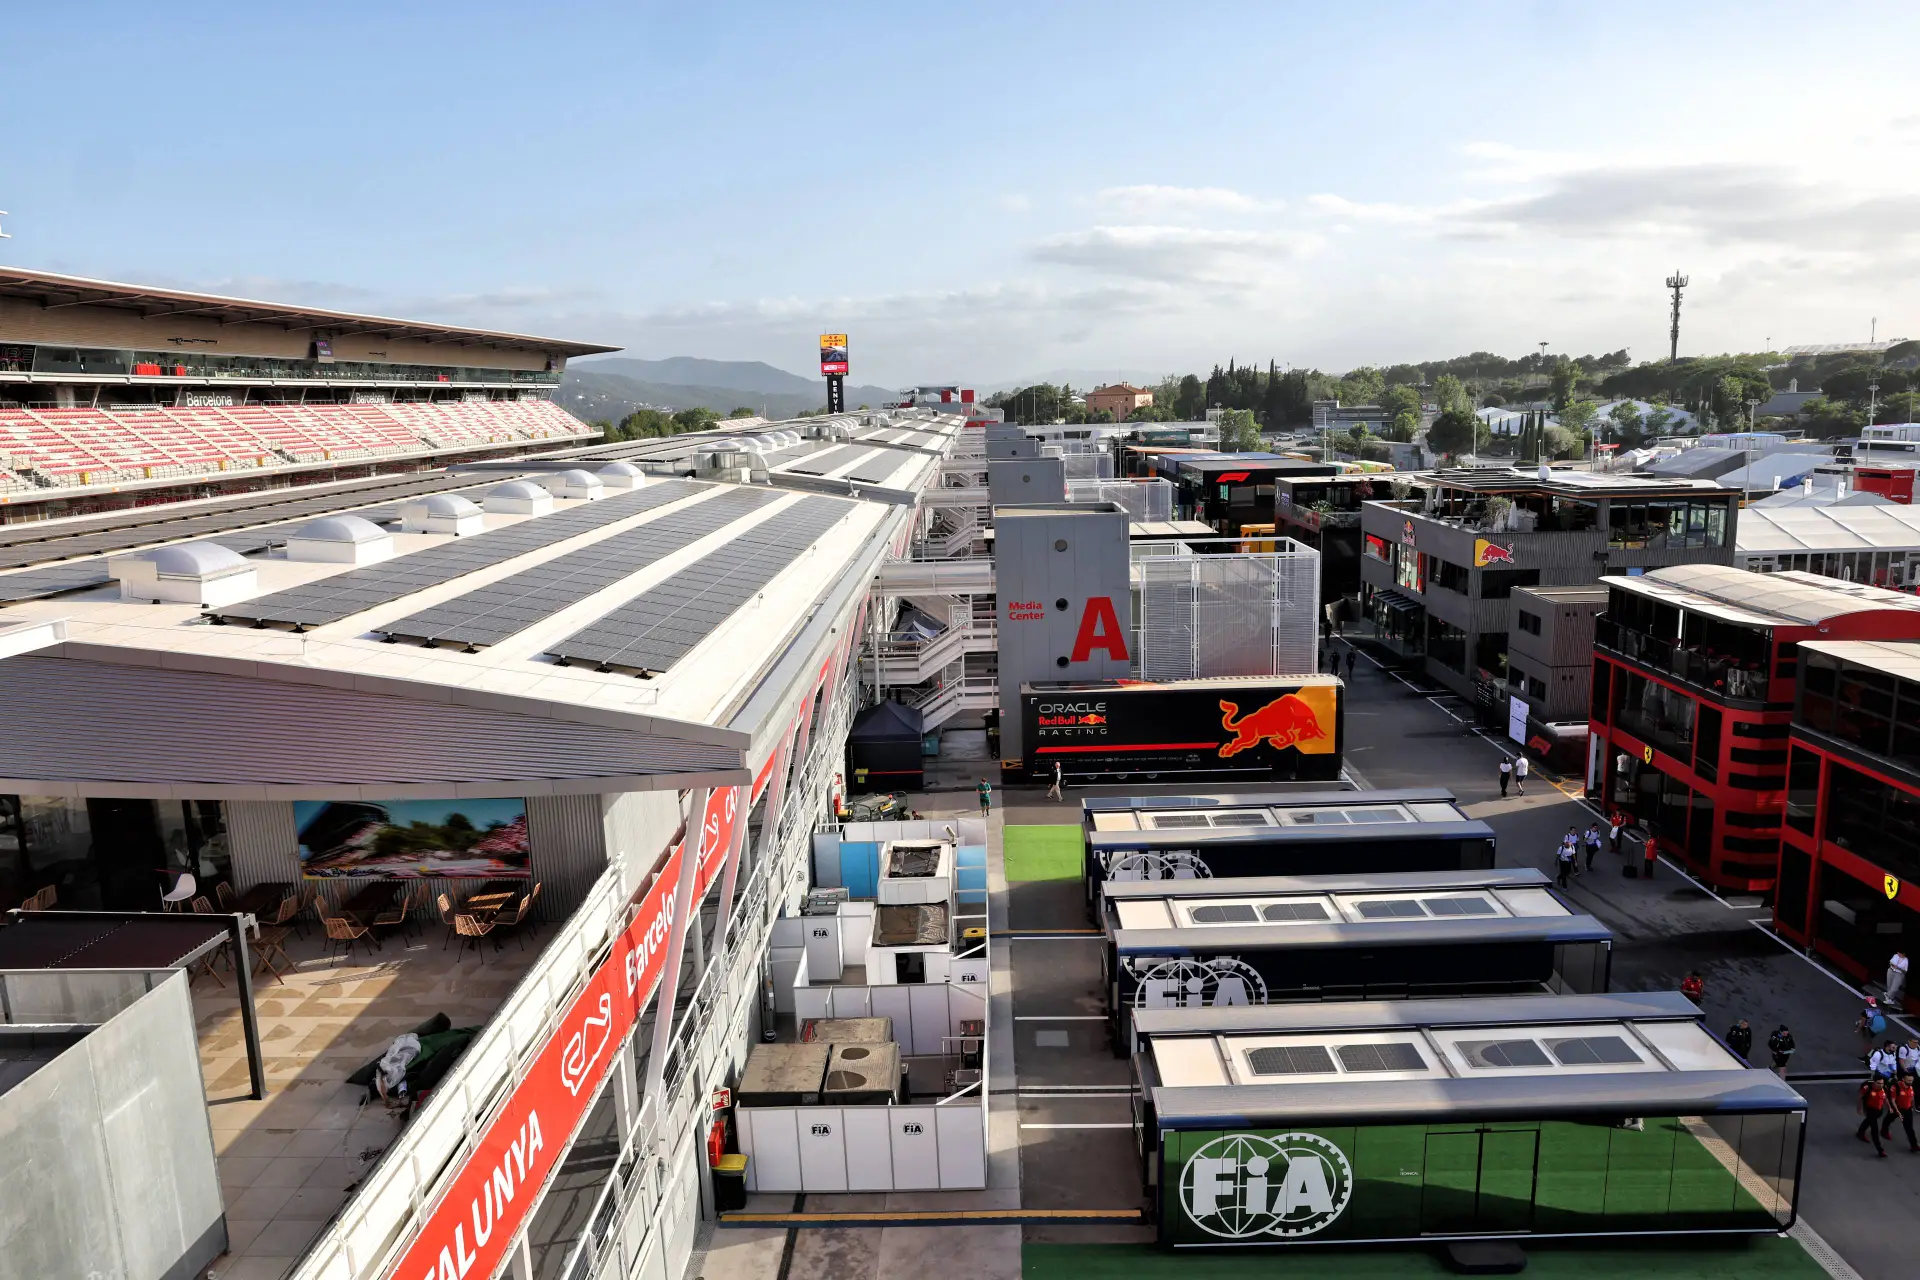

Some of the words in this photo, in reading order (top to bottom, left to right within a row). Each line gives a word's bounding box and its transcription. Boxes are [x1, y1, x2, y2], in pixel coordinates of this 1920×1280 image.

[186, 392, 232, 406] Barcelona
[356, 391, 385, 404] Barcelona
[1008, 601, 1042, 610] Media
[1009, 612, 1044, 620] Center
[1070, 597, 1129, 662] A
[1039, 702, 1106, 713] ORACLE
[1039, 728, 1107, 736] RACING
[625, 881, 679, 998] Barcelo
